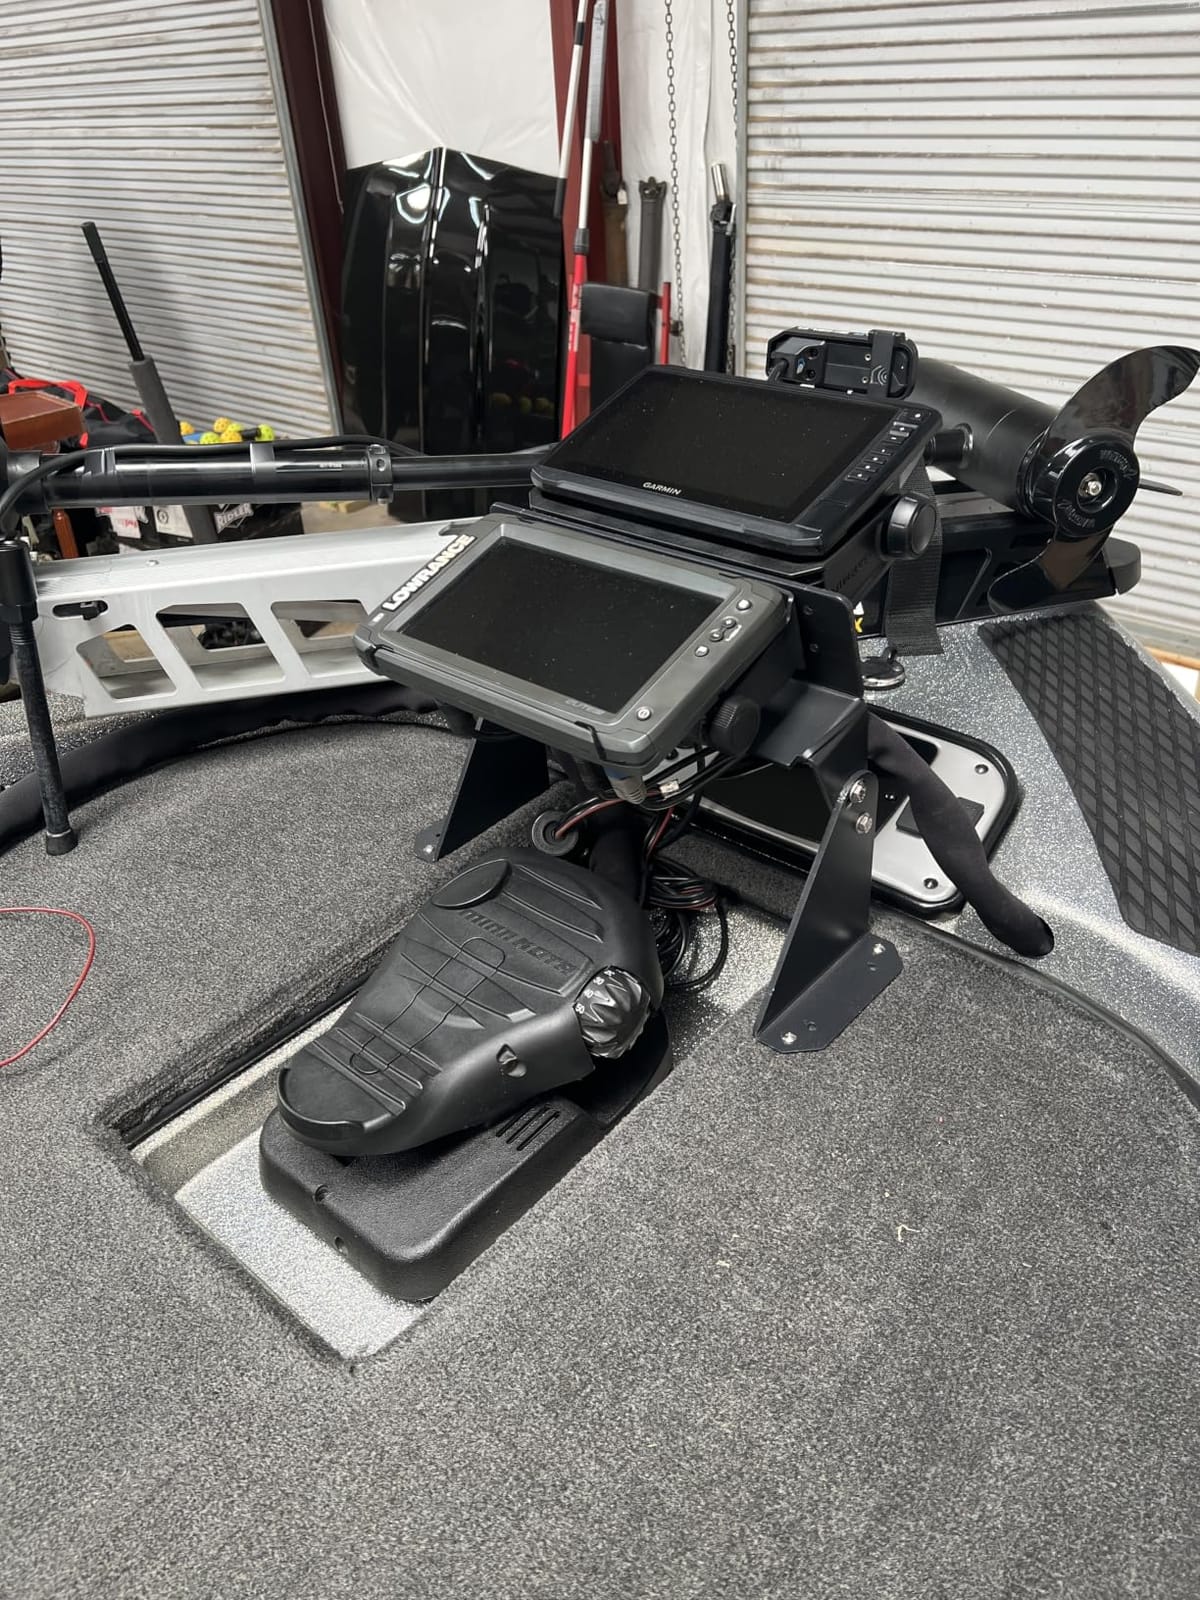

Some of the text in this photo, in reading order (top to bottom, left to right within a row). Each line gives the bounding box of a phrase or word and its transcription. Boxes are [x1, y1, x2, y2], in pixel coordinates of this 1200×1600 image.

[643, 482, 682, 495] GARMIN
[216, 503, 253, 530] RIDLER
[382, 534, 476, 611] LOWRANCE
[593, 976, 605, 985] 30
[575, 1003, 585, 1015] 50
